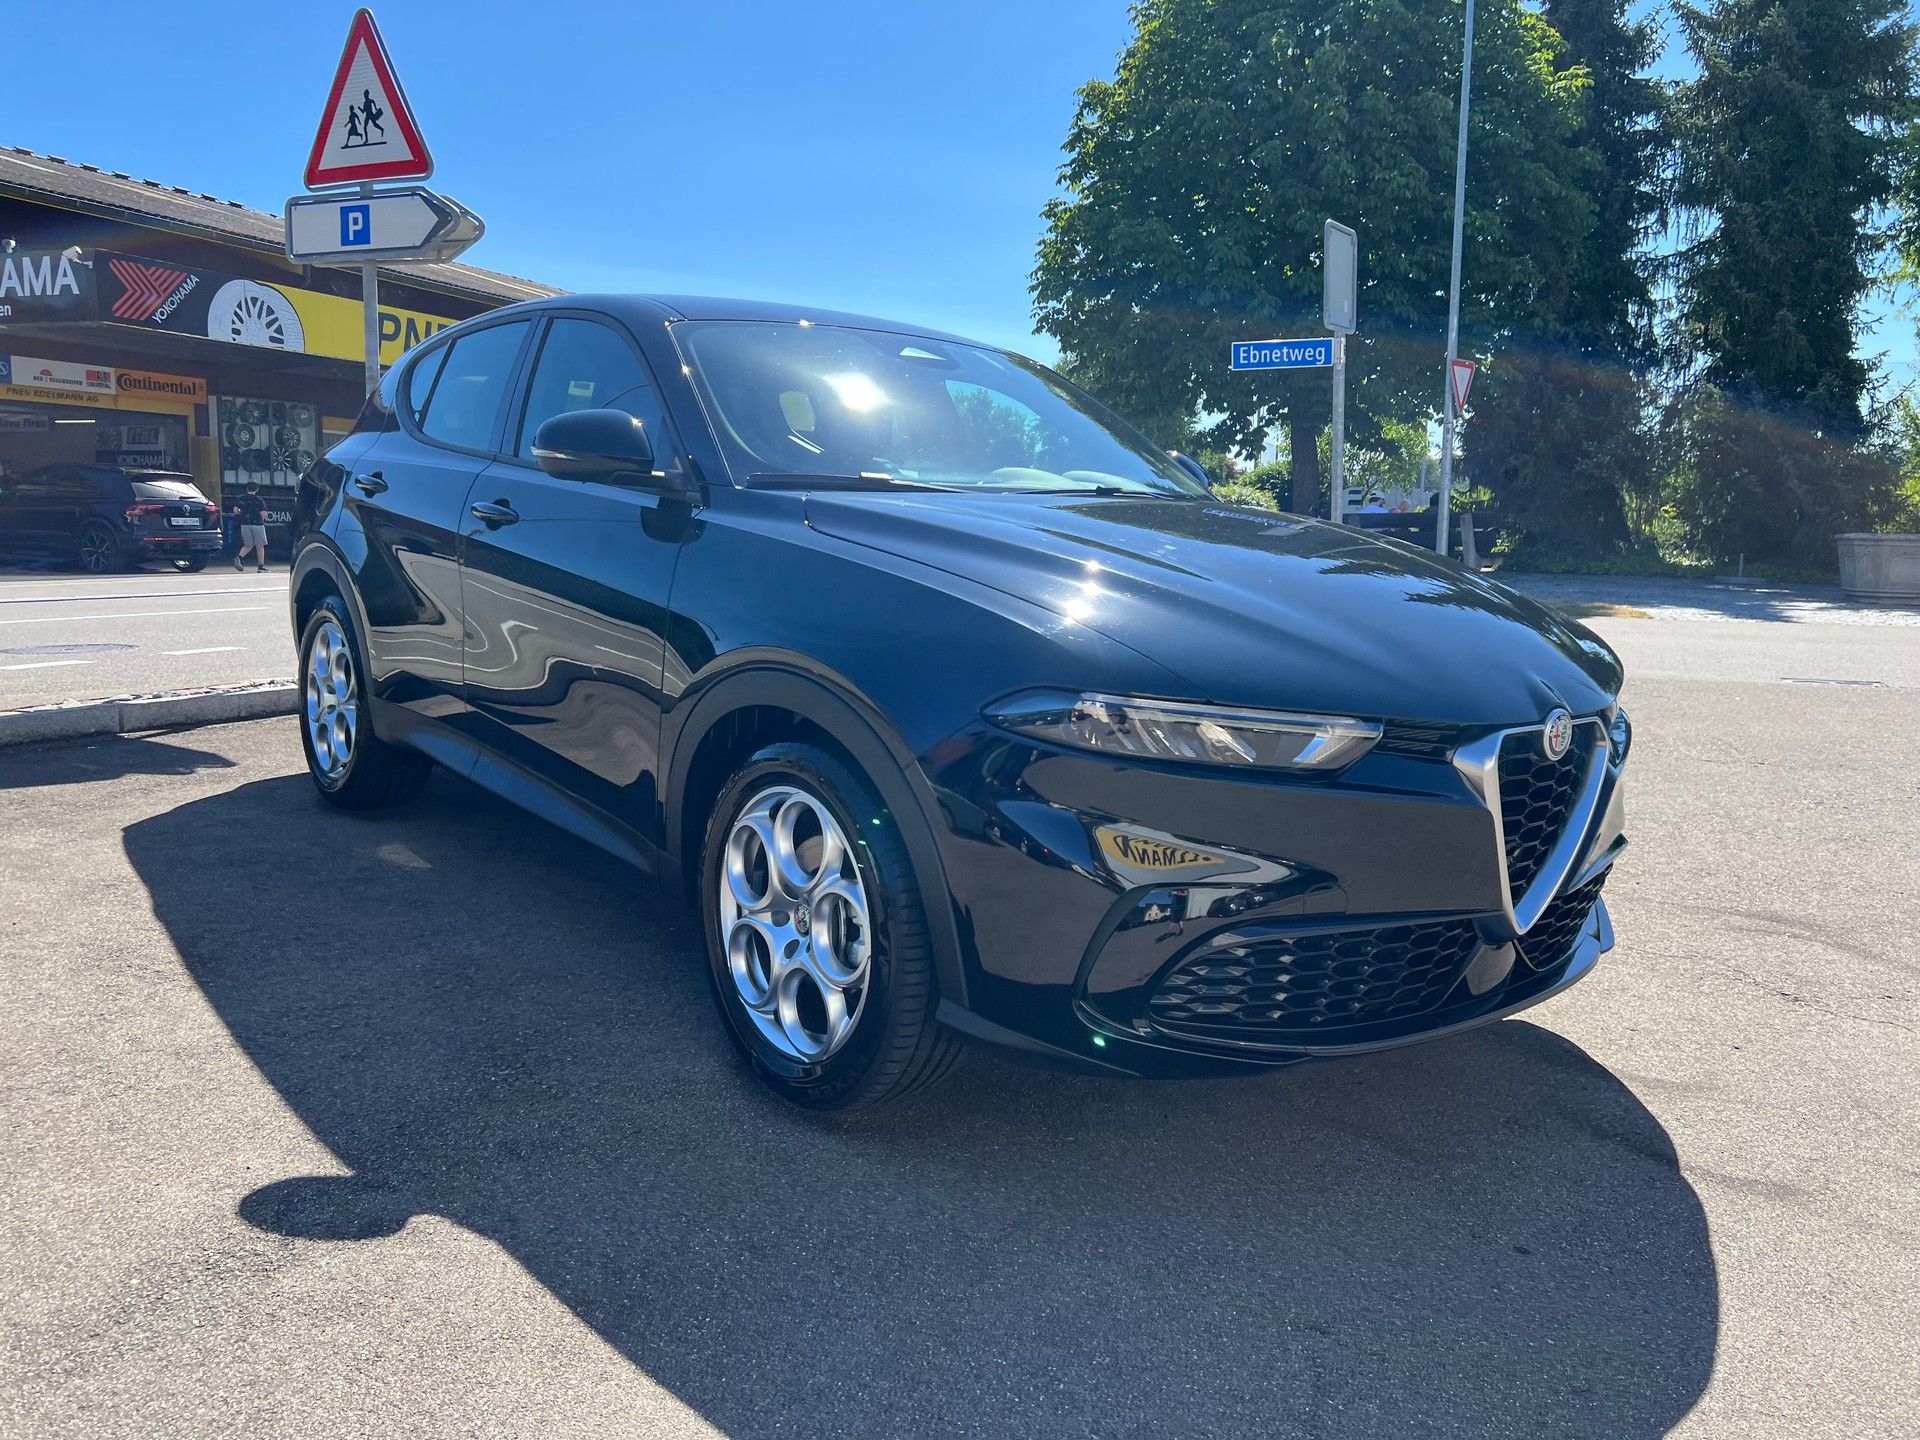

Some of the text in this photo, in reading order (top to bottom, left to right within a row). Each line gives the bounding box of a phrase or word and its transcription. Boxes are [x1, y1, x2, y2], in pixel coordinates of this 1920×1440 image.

[348, 212, 364, 241] P
[152, 275, 200, 324] YOKOHAMA
[1239, 345, 1326, 365] Ebnetweg
[6, 387, 99, 403] PNEU EDELMANN AG
[116, 373, 197, 396] Continental
[116, 453, 164, 467] YOKOHAMA
